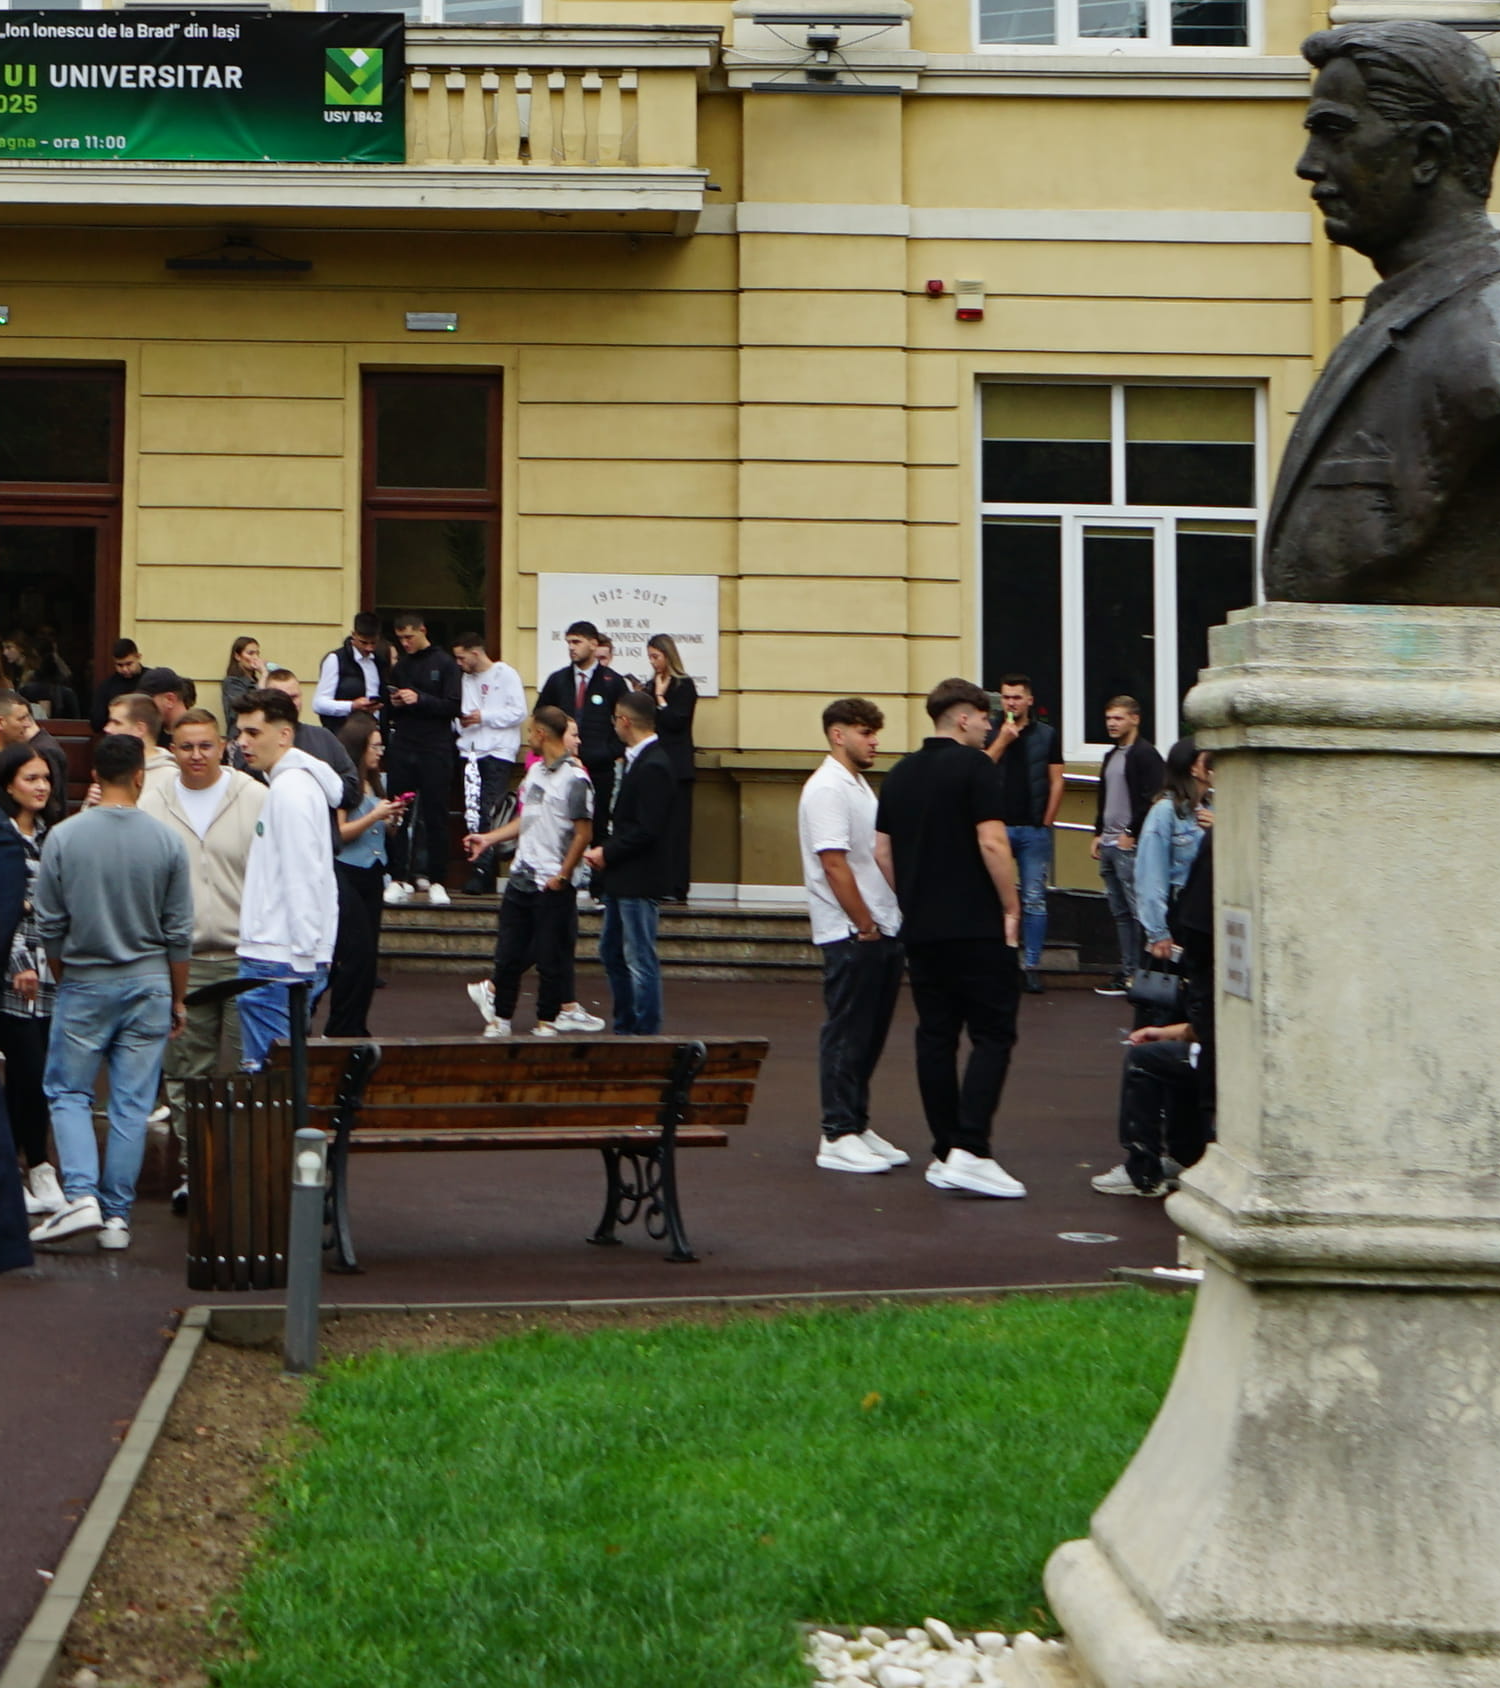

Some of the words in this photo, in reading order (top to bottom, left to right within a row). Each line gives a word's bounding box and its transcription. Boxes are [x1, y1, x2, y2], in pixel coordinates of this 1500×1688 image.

[33, 23, 94, 39] Ionescu
[97, 23, 117, 38] de
[120, 23, 134, 39] la
[184, 23, 209, 39] din
[212, 24, 241, 42] Iași
[50, 64, 243, 89] UNIVERSITAR
[323, 110, 352, 123] USV
[353, 110, 384, 123] 1842
[53, 138, 80, 149] ora
[85, 136, 127, 150] 11:00
